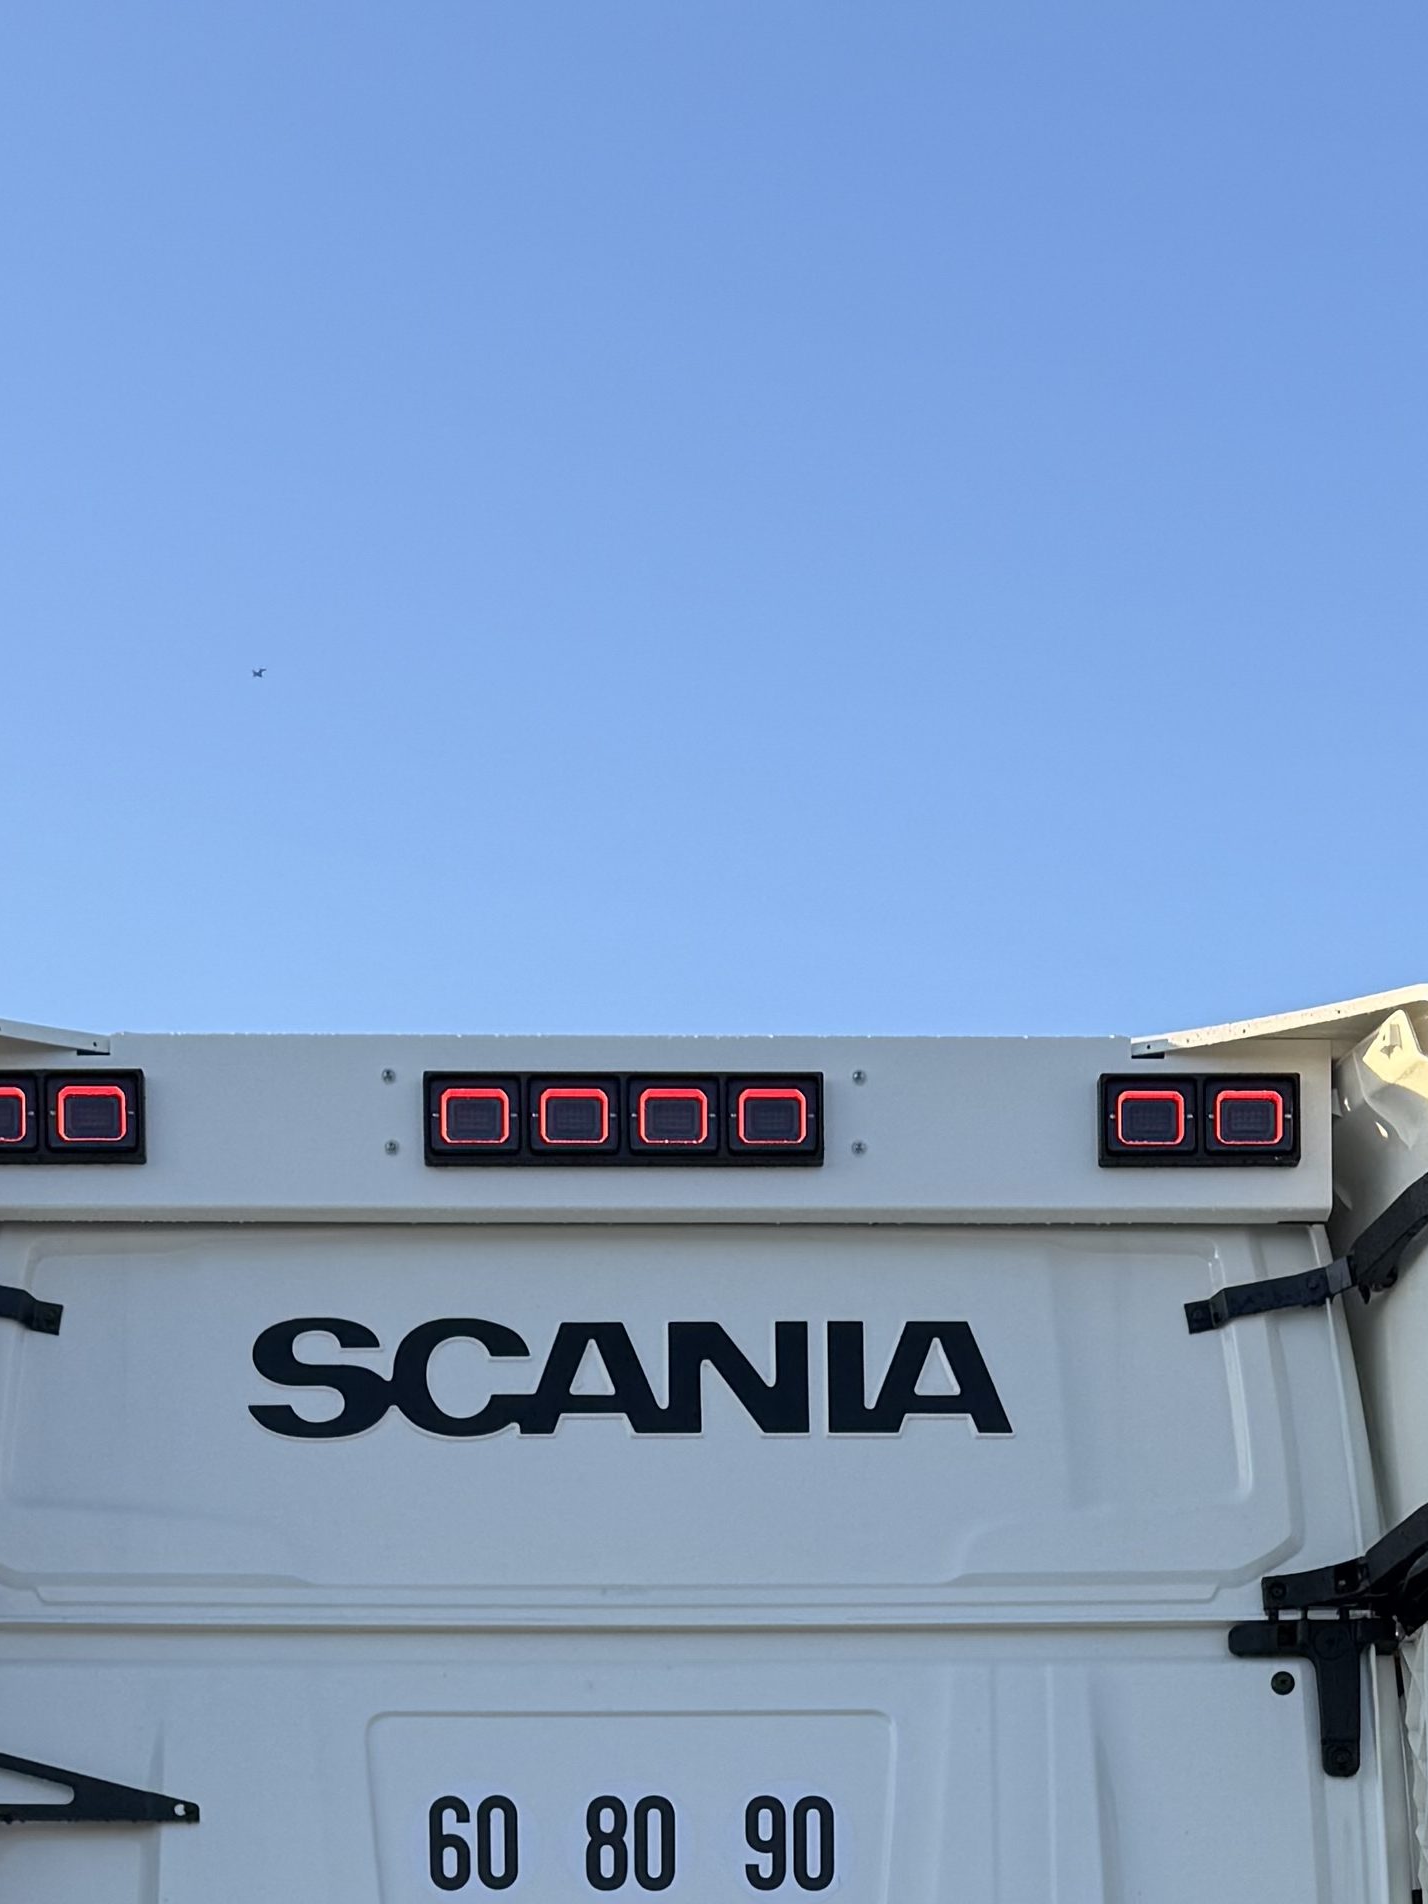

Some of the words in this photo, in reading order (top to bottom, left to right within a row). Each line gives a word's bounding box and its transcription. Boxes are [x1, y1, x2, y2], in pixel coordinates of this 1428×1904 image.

[249, 1317, 1014, 1437] SCANIA
[429, 1795, 520, 1893] 60
[586, 1795, 677, 1893] 80
[745, 1796, 836, 1893] 90
